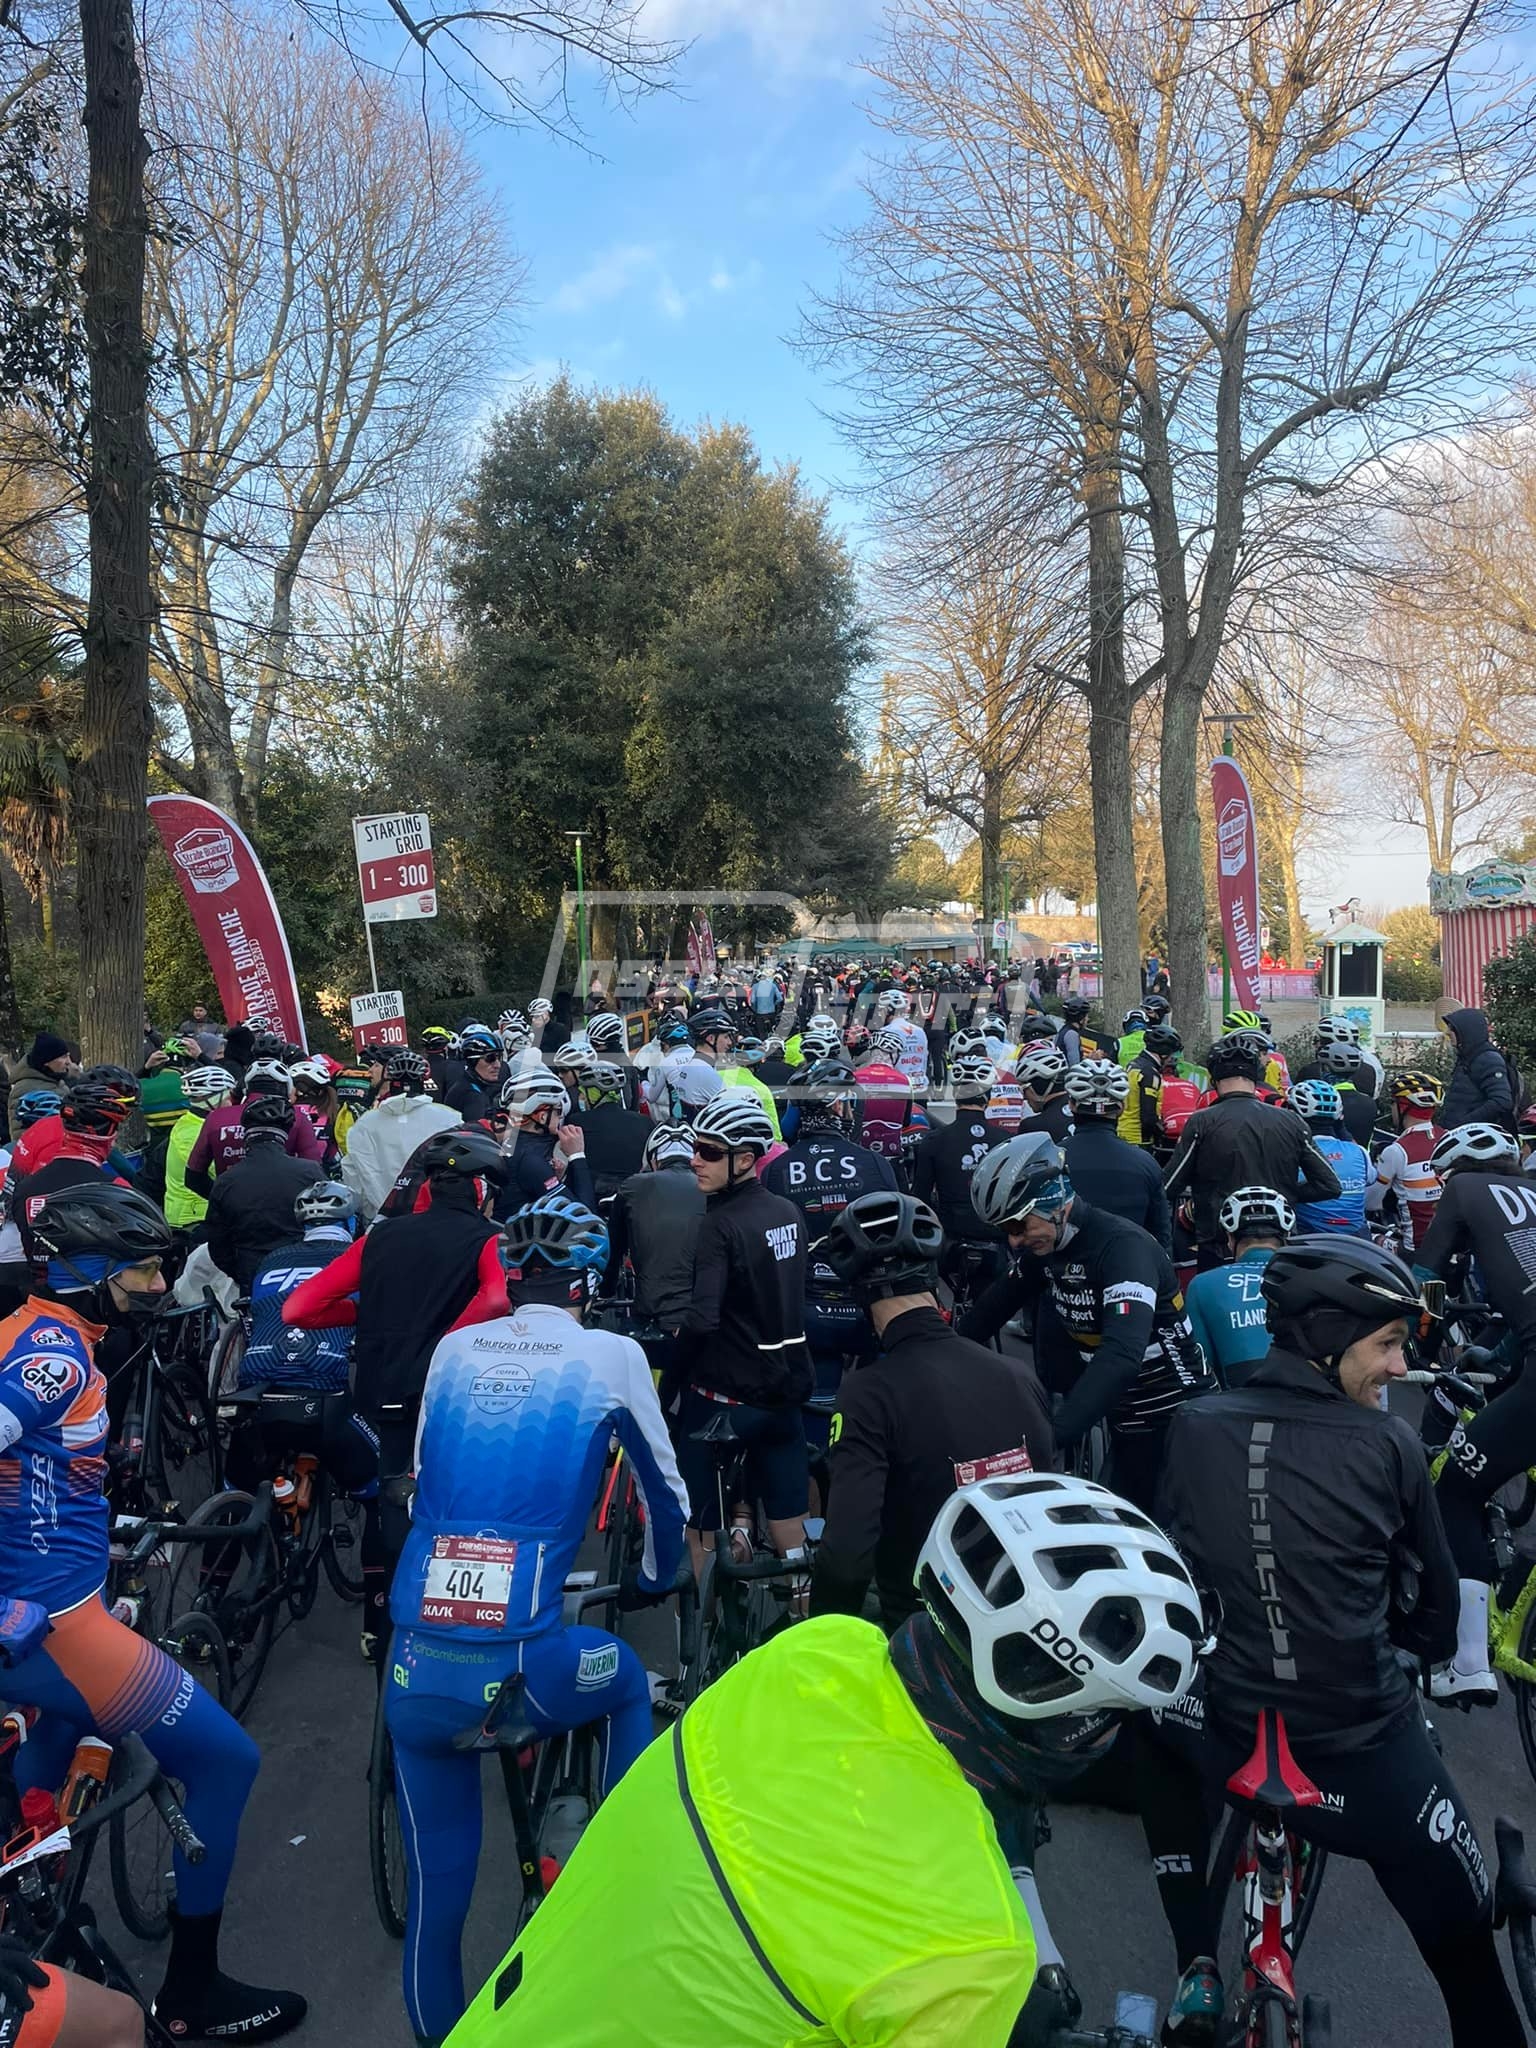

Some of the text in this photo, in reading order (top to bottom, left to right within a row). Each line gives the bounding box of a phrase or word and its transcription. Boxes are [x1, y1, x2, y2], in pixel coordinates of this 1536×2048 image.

[365, 816, 421, 842] STARTING
[396, 833, 424, 854] GRID
[398, 864, 428, 887] 300
[217, 908, 256, 972] BIANCHE
[1231, 895, 1258, 971] BIANCHE
[248, 938, 272, 985] LEGEND
[263, 988, 279, 1013] THE
[356, 993, 397, 1012] STARTING
[378, 1005, 399, 1020] GRID
[380, 1026, 402, 1044] 300
[765, 1222, 798, 1247] SWATT
[773, 1240, 797, 1261] CLUB
[1230, 1308, 1267, 1329] FLAND
[473, 1337, 517, 1350] Maurizio
[23, 1367, 61, 1402] GMG
[445, 1568, 484, 1600] 404
